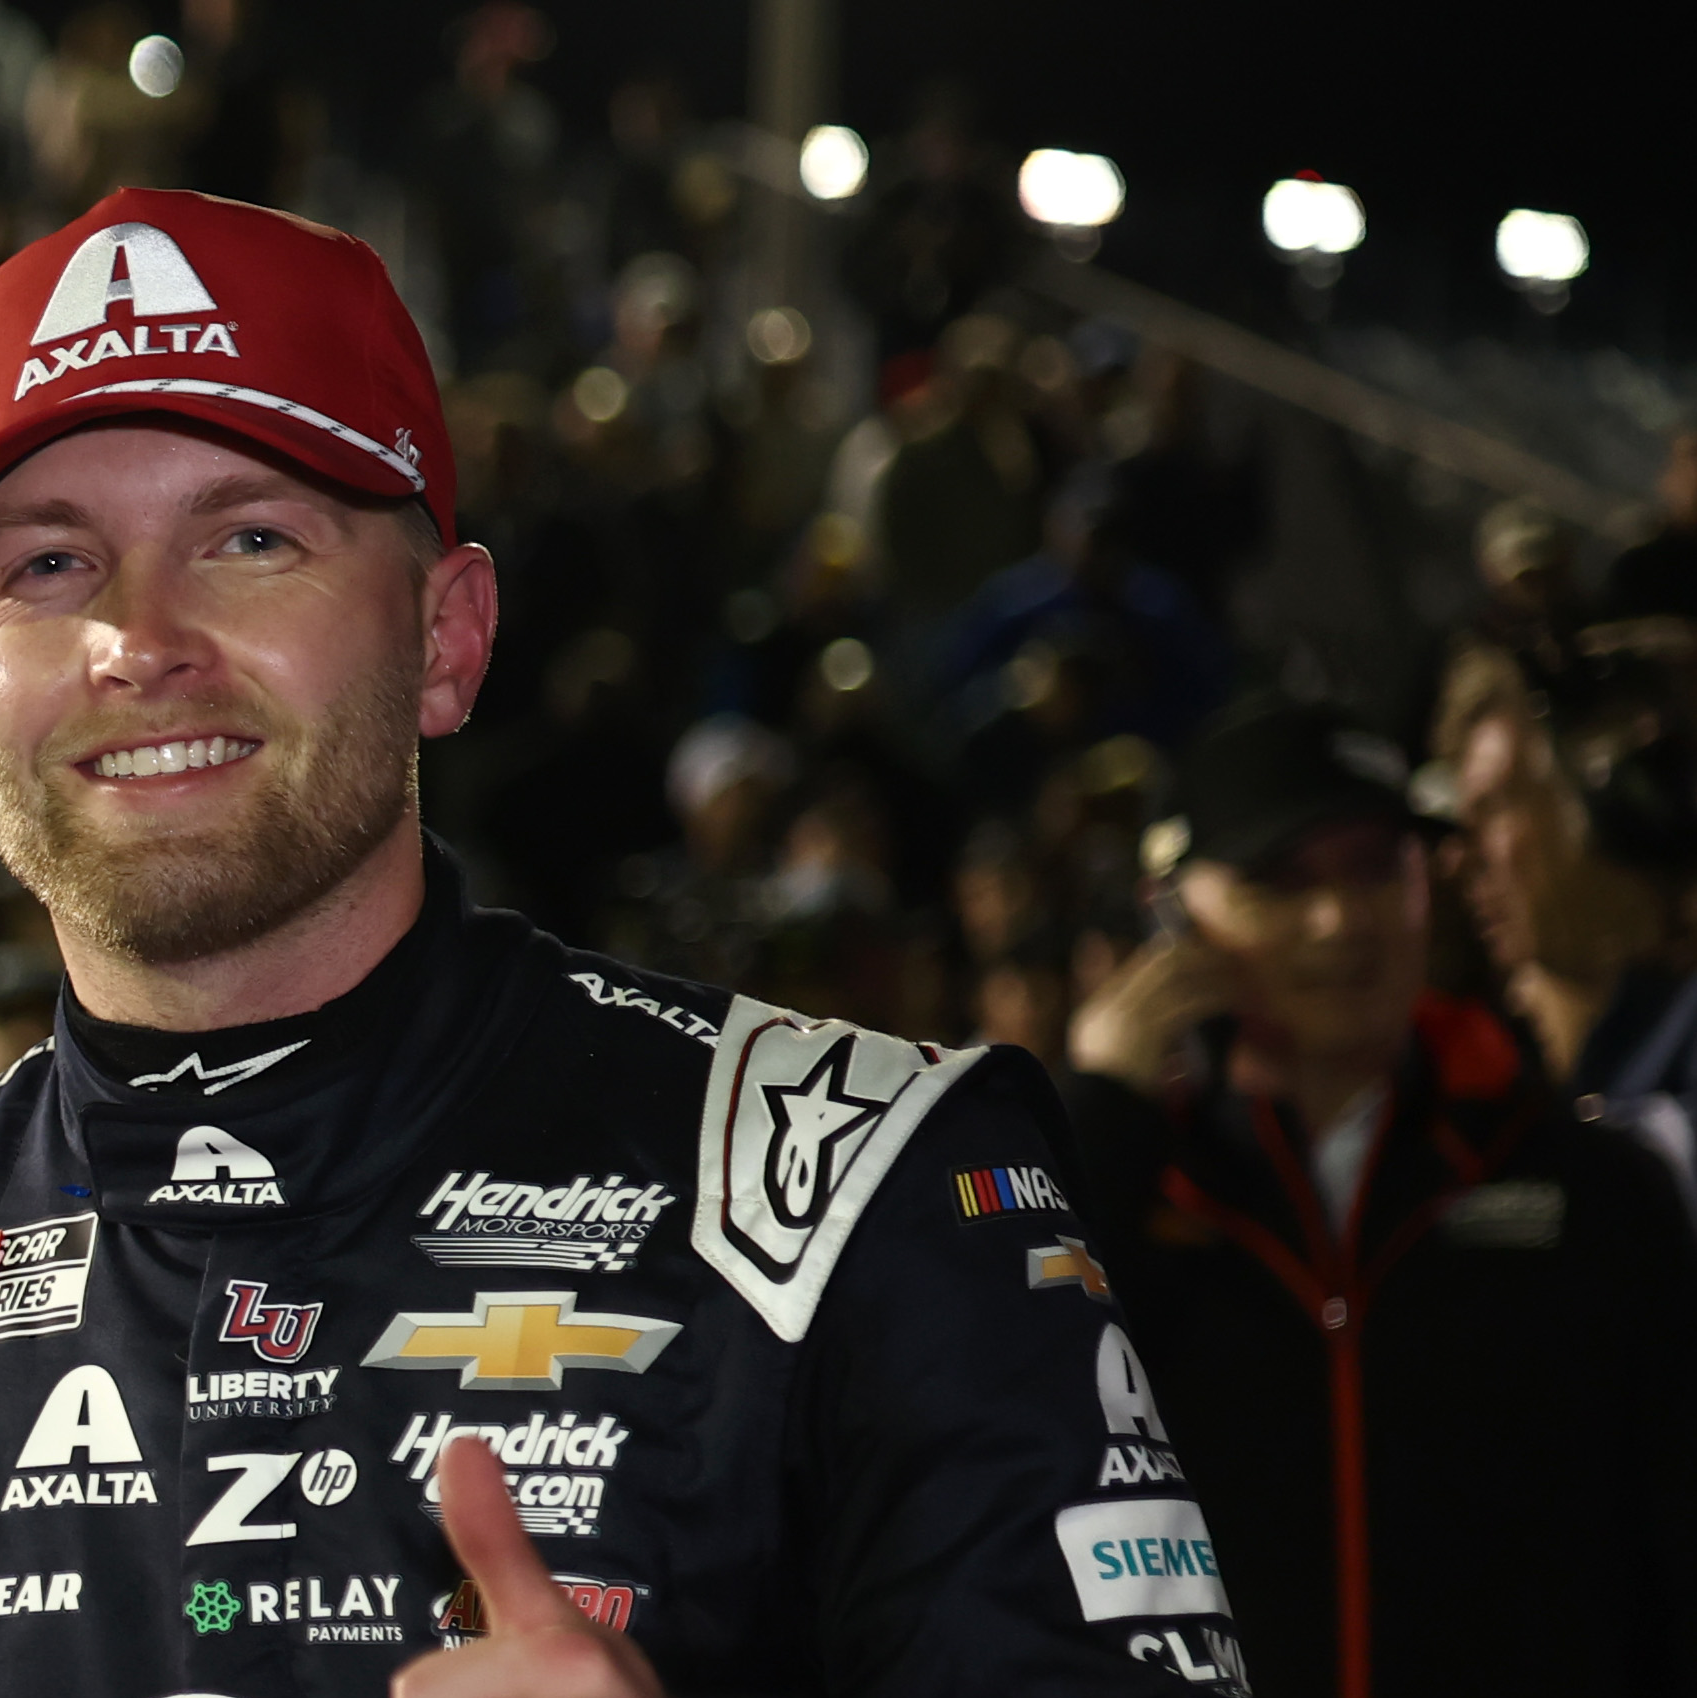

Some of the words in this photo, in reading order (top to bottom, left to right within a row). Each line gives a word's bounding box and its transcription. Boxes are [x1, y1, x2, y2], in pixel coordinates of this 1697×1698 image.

[14, 322, 240, 401] AXALTA
[147, 1182, 286, 1206] AXALTA
[420, 1171, 675, 1231] Hendrick
[455, 1216, 652, 1240] MOTORSPORTS
[189, 1369, 340, 1404] LIBERTY
[189, 1396, 335, 1421] UNIVERSITY
[1, 1471, 157, 1511] AXALTA
[250, 1578, 402, 1623] RELAY
[308, 1623, 403, 1642] PAYMENTS
